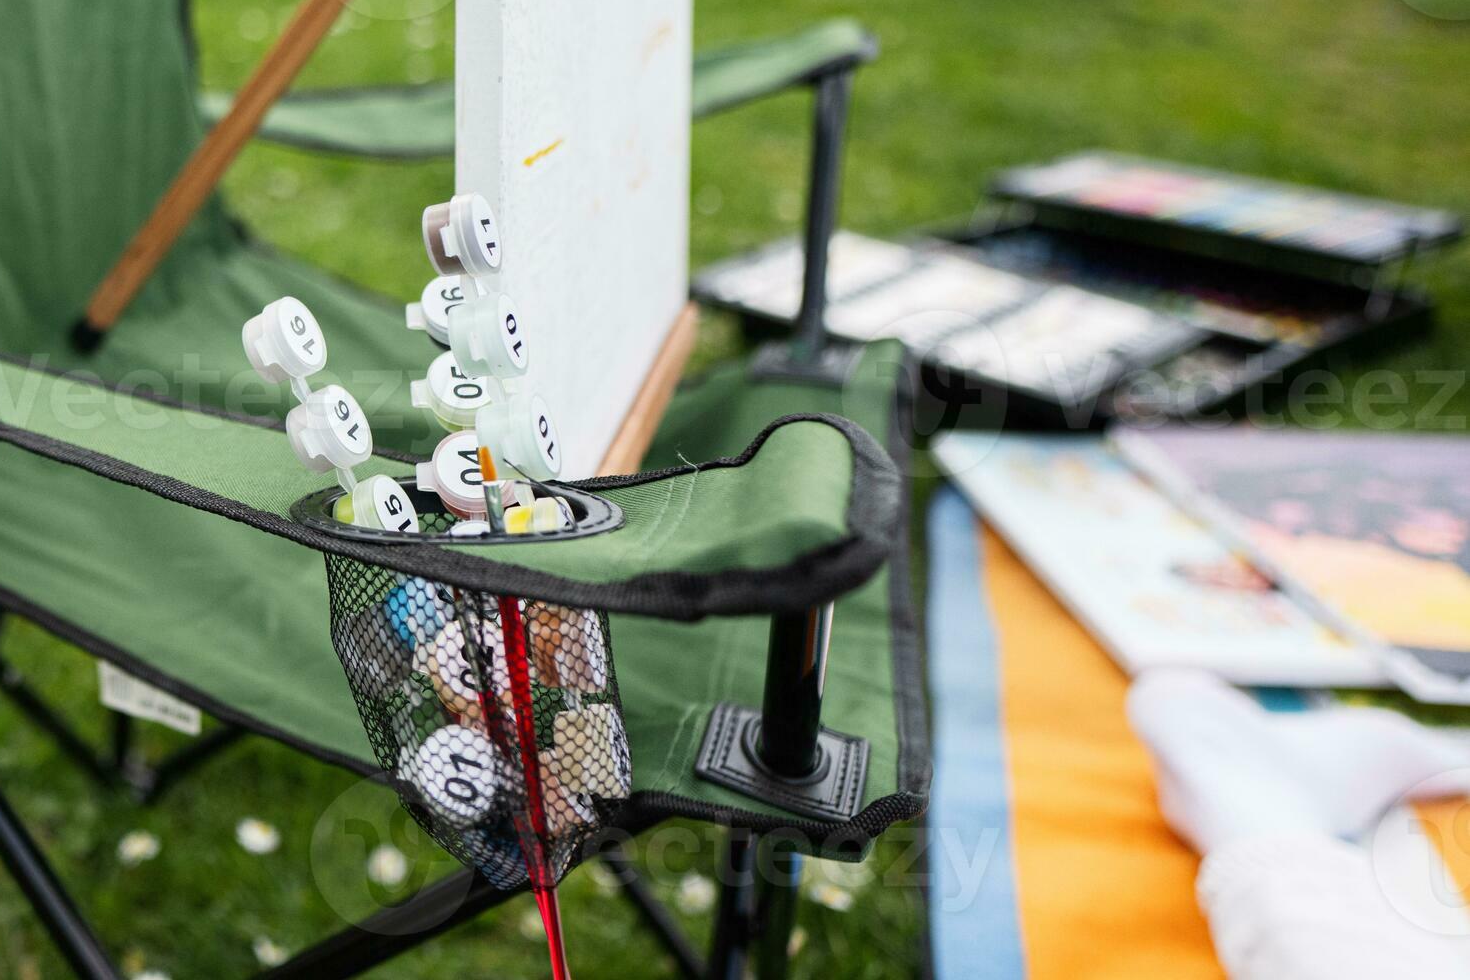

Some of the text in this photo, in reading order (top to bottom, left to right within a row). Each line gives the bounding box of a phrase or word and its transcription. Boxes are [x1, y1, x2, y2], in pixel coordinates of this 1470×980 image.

[480, 219, 496, 257] 11
[290, 315, 315, 355] 16
[506, 314, 522, 358] 10
[334, 400, 359, 441] 16
[539, 415, 554, 460] 10
[445, 754, 483, 801] 01
